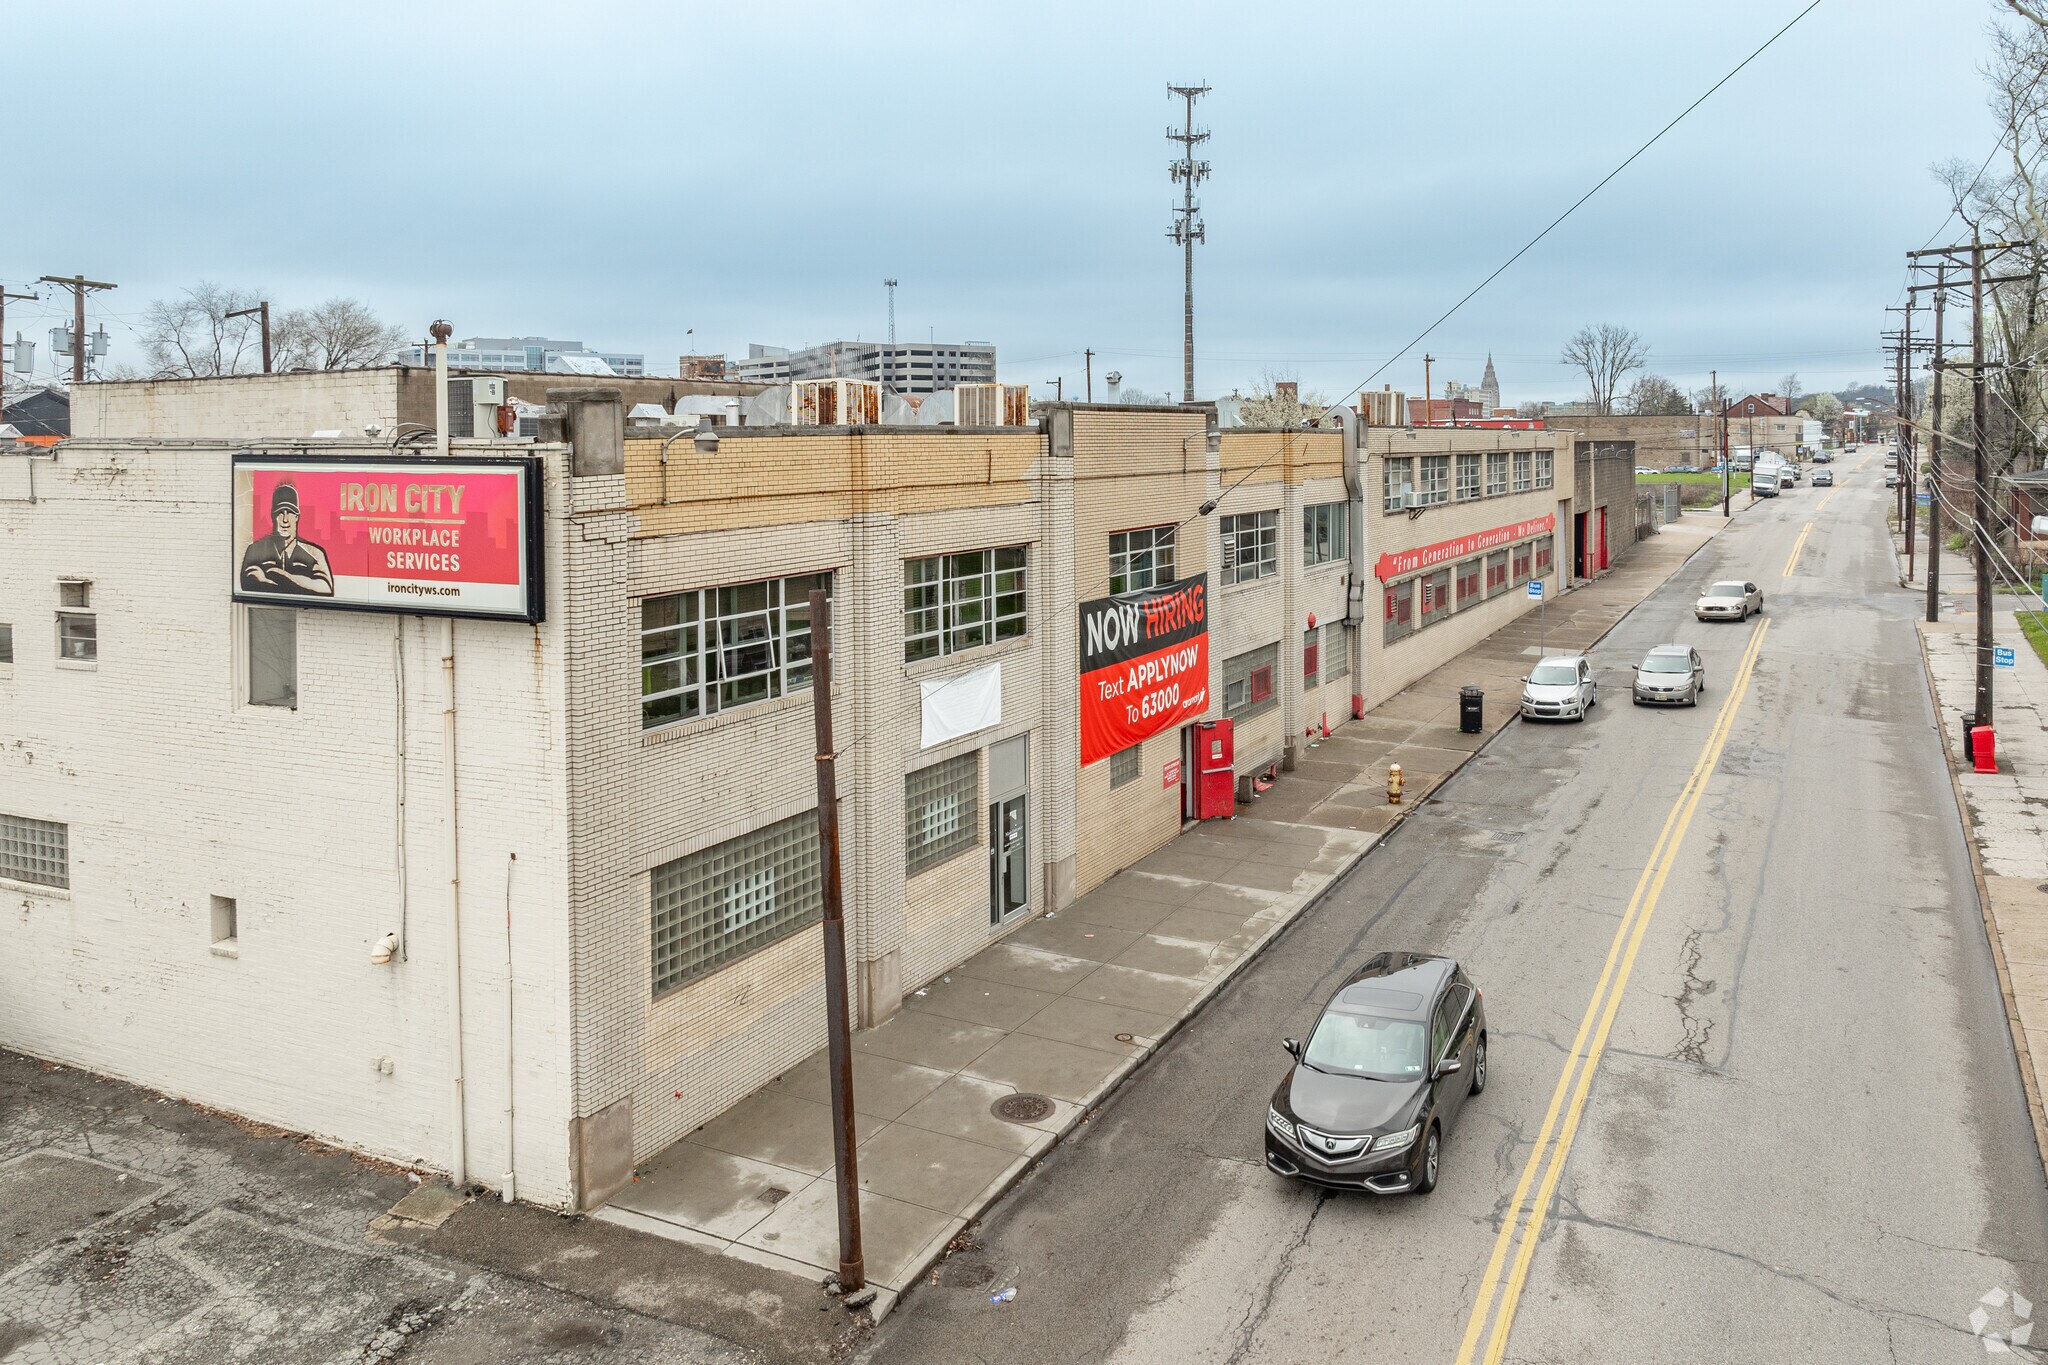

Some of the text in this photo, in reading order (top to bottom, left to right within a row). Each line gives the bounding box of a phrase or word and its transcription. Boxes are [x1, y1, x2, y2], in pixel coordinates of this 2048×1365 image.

[340, 483, 465, 514] IRON CITY
[369, 527, 460, 548] WORKPLACE
[1422, 541, 1463, 565] Generation
[1468, 538, 1475, 551] to
[1477, 528, 1510, 549] Generation
[1517, 524, 1525, 537] We
[387, 551, 460, 572] SERVICES
[387, 582, 461, 597] ironcityws.com
[1087, 584, 1204, 656] NOW HIRING
[1098, 644, 1199, 701] Text APPLYNOW
[1995, 656, 2014, 665] Stop
[1126, 683, 1180, 725] To 63000
